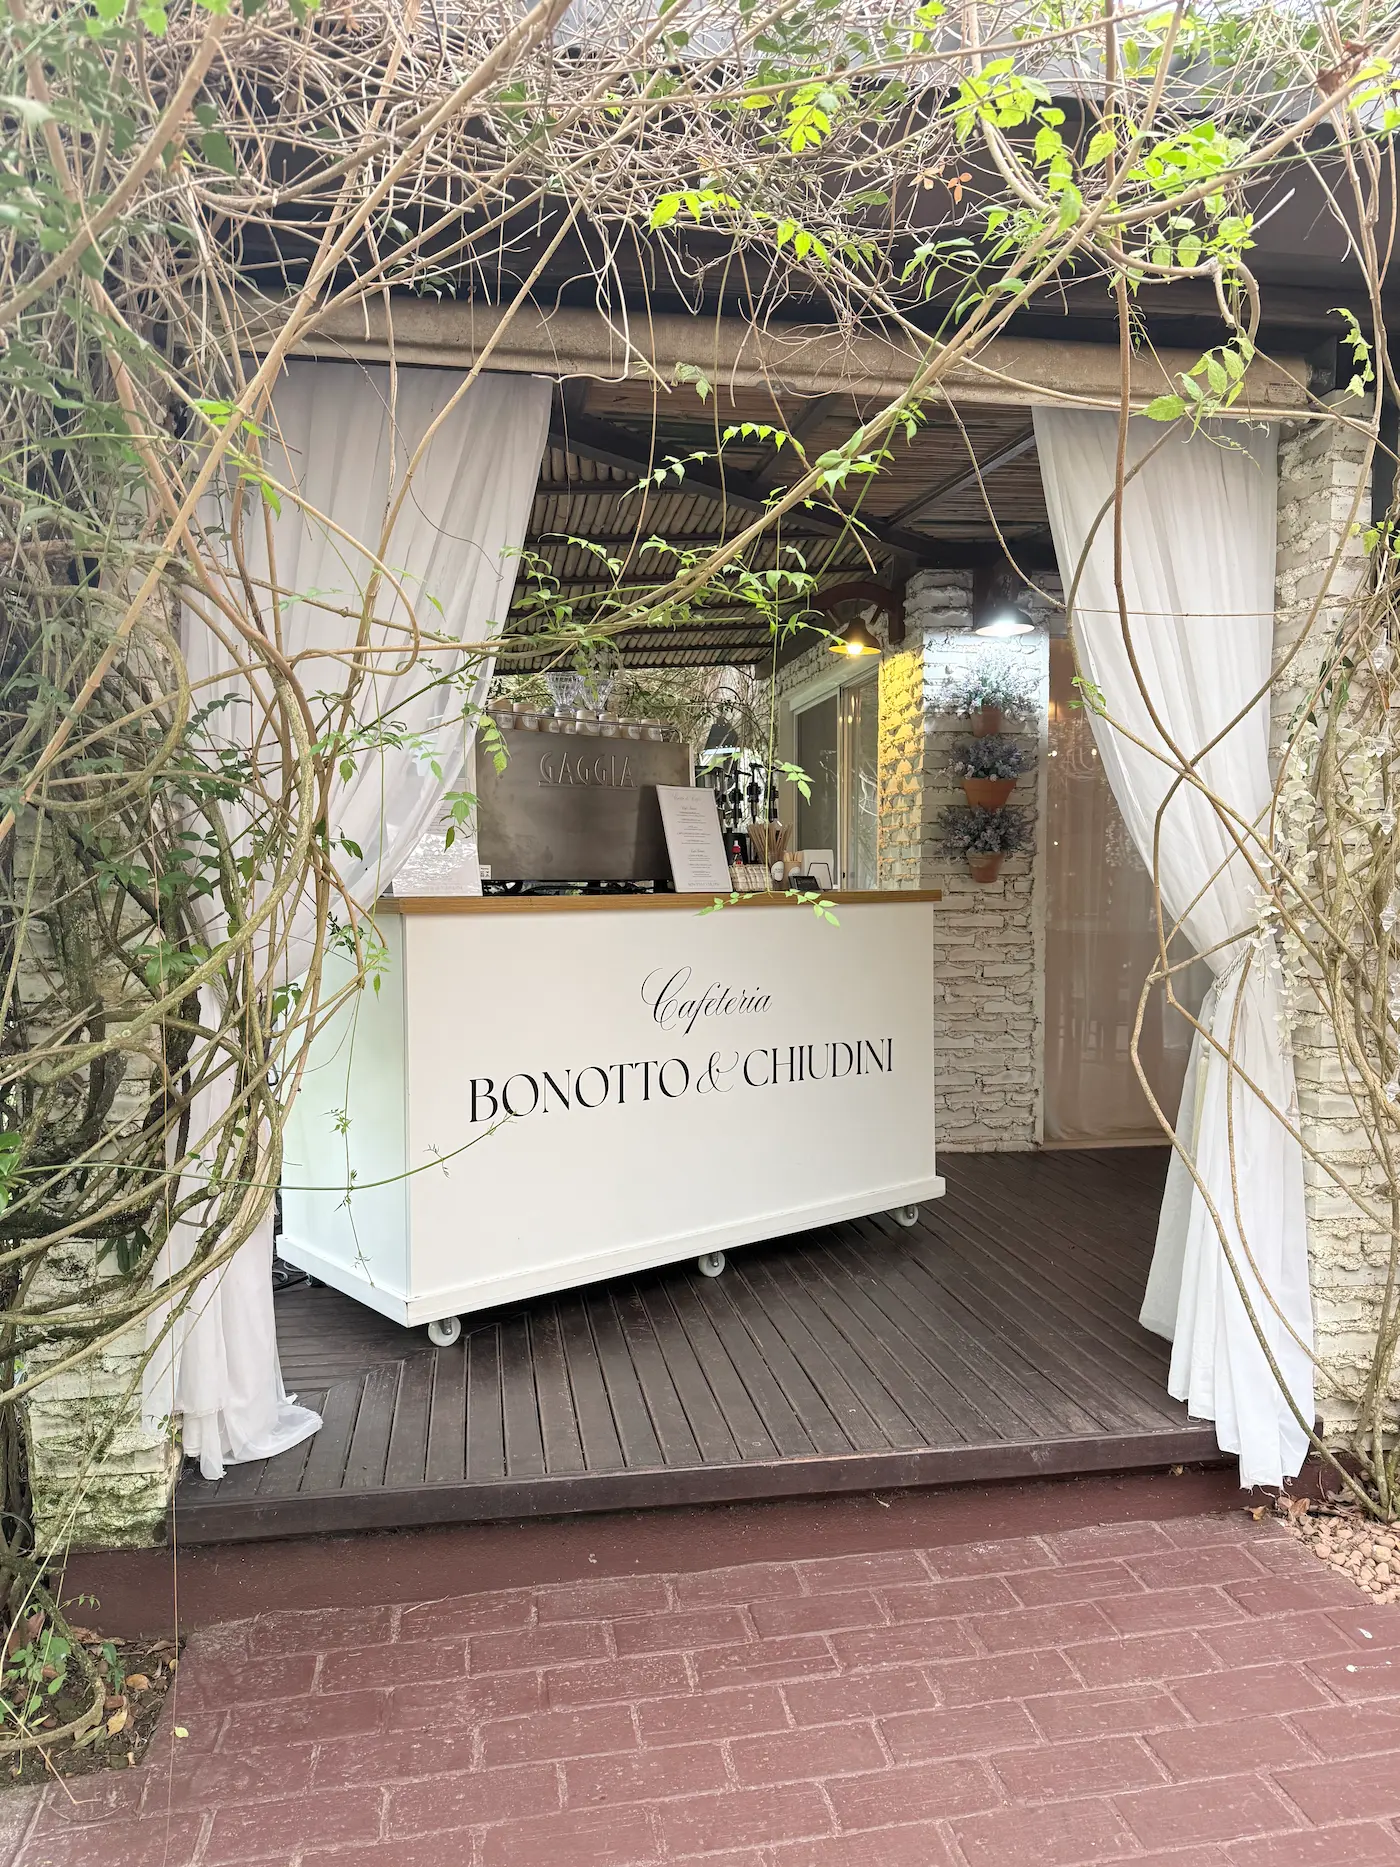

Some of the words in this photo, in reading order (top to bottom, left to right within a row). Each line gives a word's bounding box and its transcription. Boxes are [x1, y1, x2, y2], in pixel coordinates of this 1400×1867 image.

[540, 752, 635, 787] GAGGIA
[641, 966, 772, 1036] Cafeteria
[469, 1058, 690, 1123] BONOTTO
[696, 1051, 739, 1094] &
[743, 1038, 893, 1087] CHIUDINI
